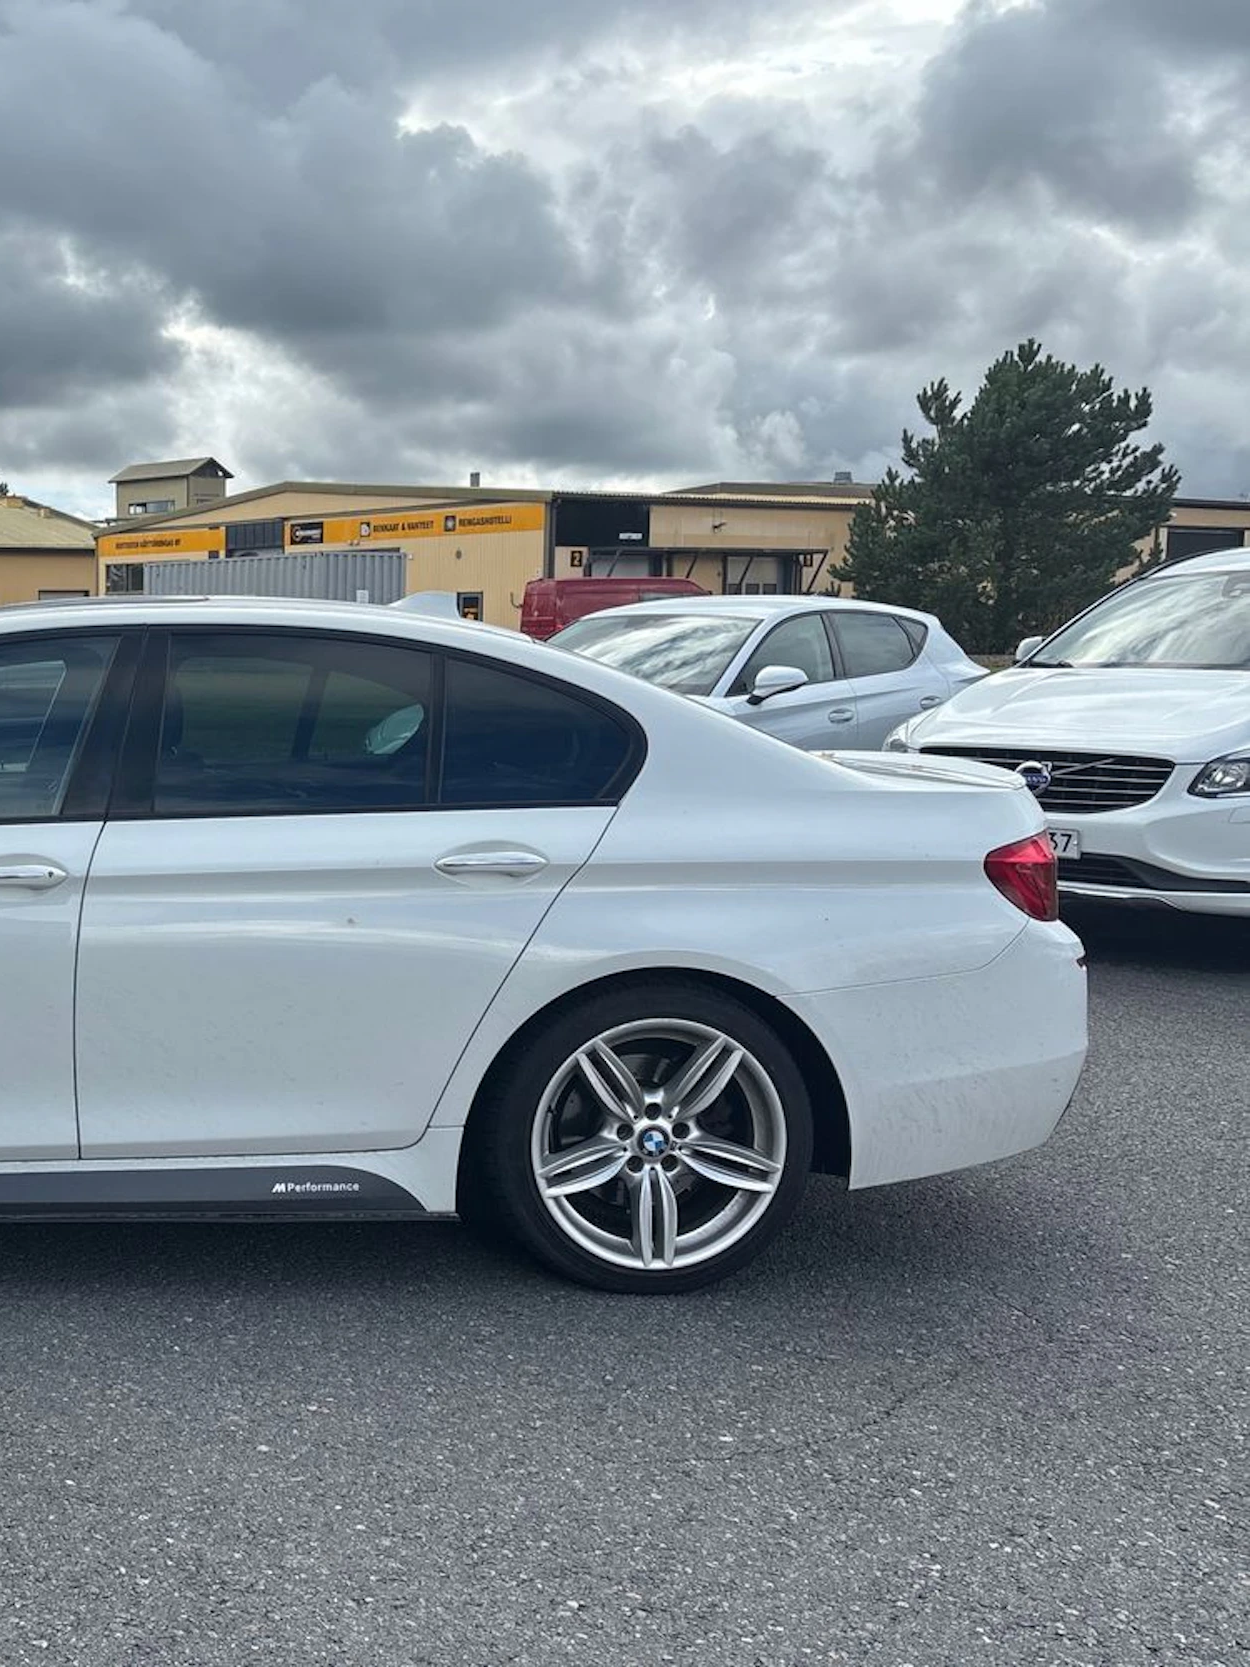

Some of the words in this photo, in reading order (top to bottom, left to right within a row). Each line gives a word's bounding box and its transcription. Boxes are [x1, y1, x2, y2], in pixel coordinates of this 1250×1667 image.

[572, 552, 580, 566] 2
[1048, 831, 1072, 852] 37
[287, 1182, 360, 1193] Performance
